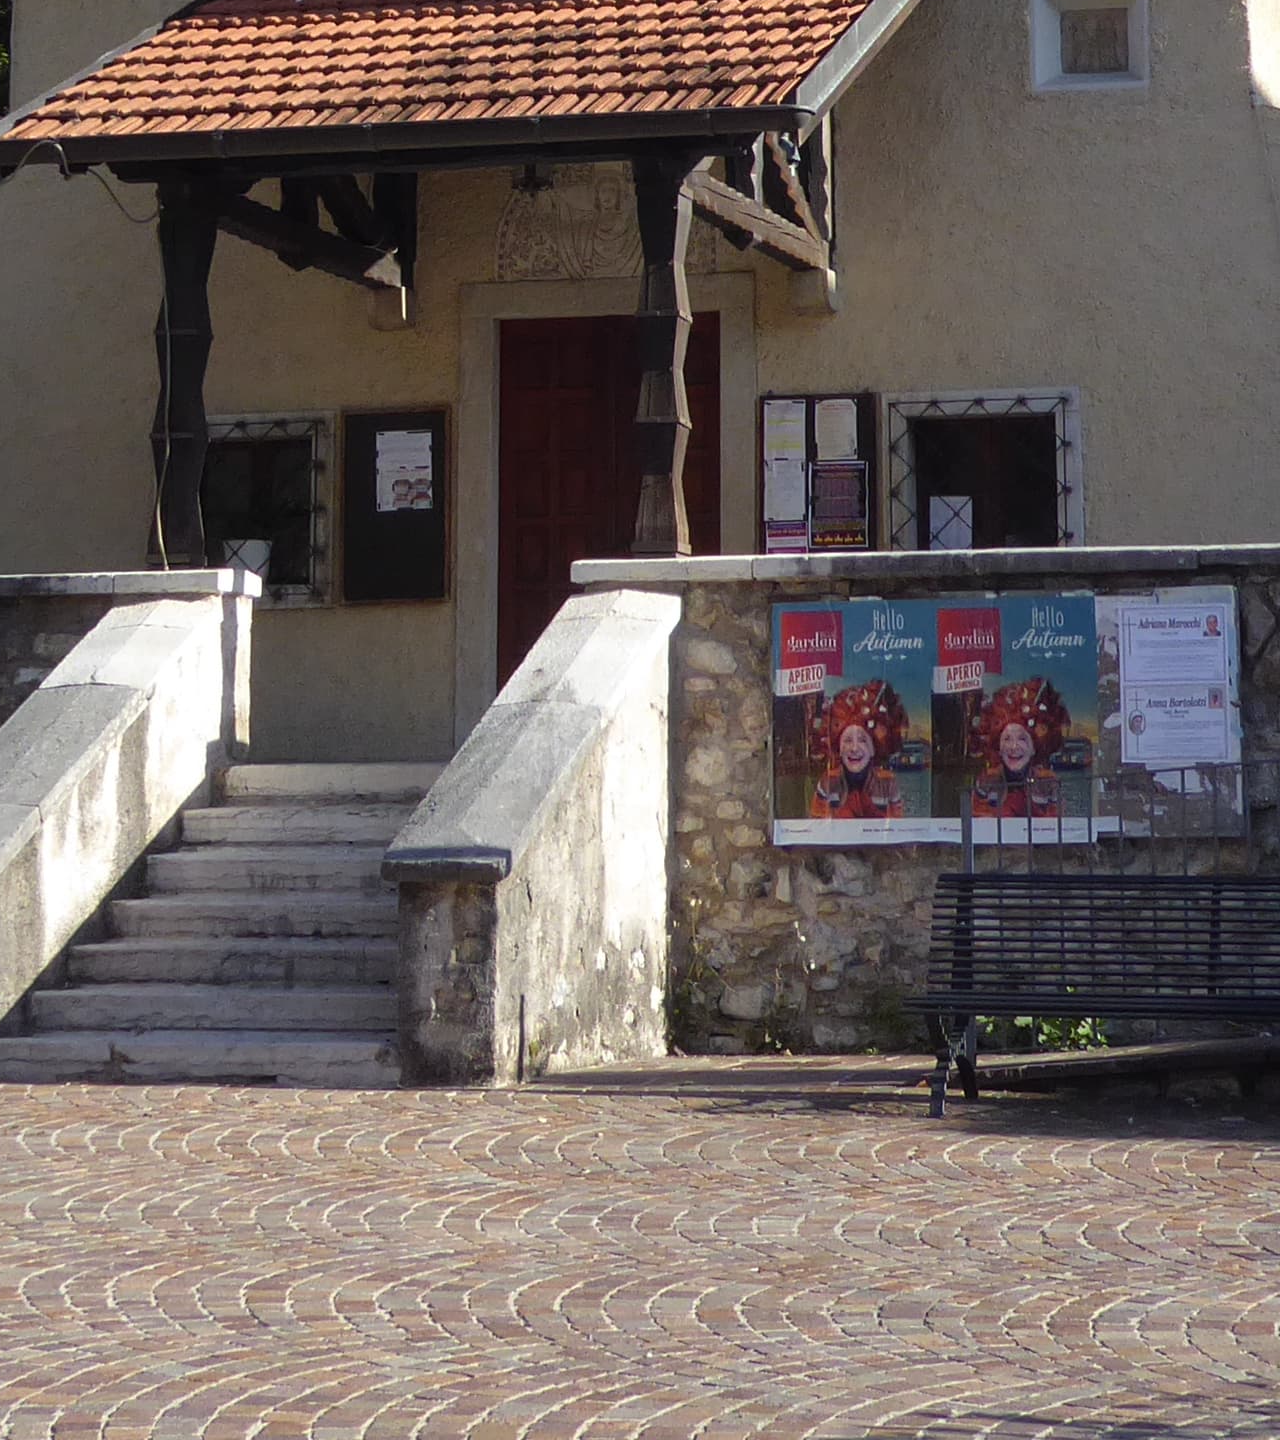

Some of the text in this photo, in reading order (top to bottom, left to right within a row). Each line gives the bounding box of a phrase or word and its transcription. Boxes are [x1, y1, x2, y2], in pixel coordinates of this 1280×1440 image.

[873, 608, 904, 631] Hello
[1032, 605, 1064, 628] Hello
[853, 631, 923, 653] Autumn
[1012, 628, 1085, 650] Autumn
[788, 666, 823, 684] APERTO
[947, 663, 981, 682] APERTO
